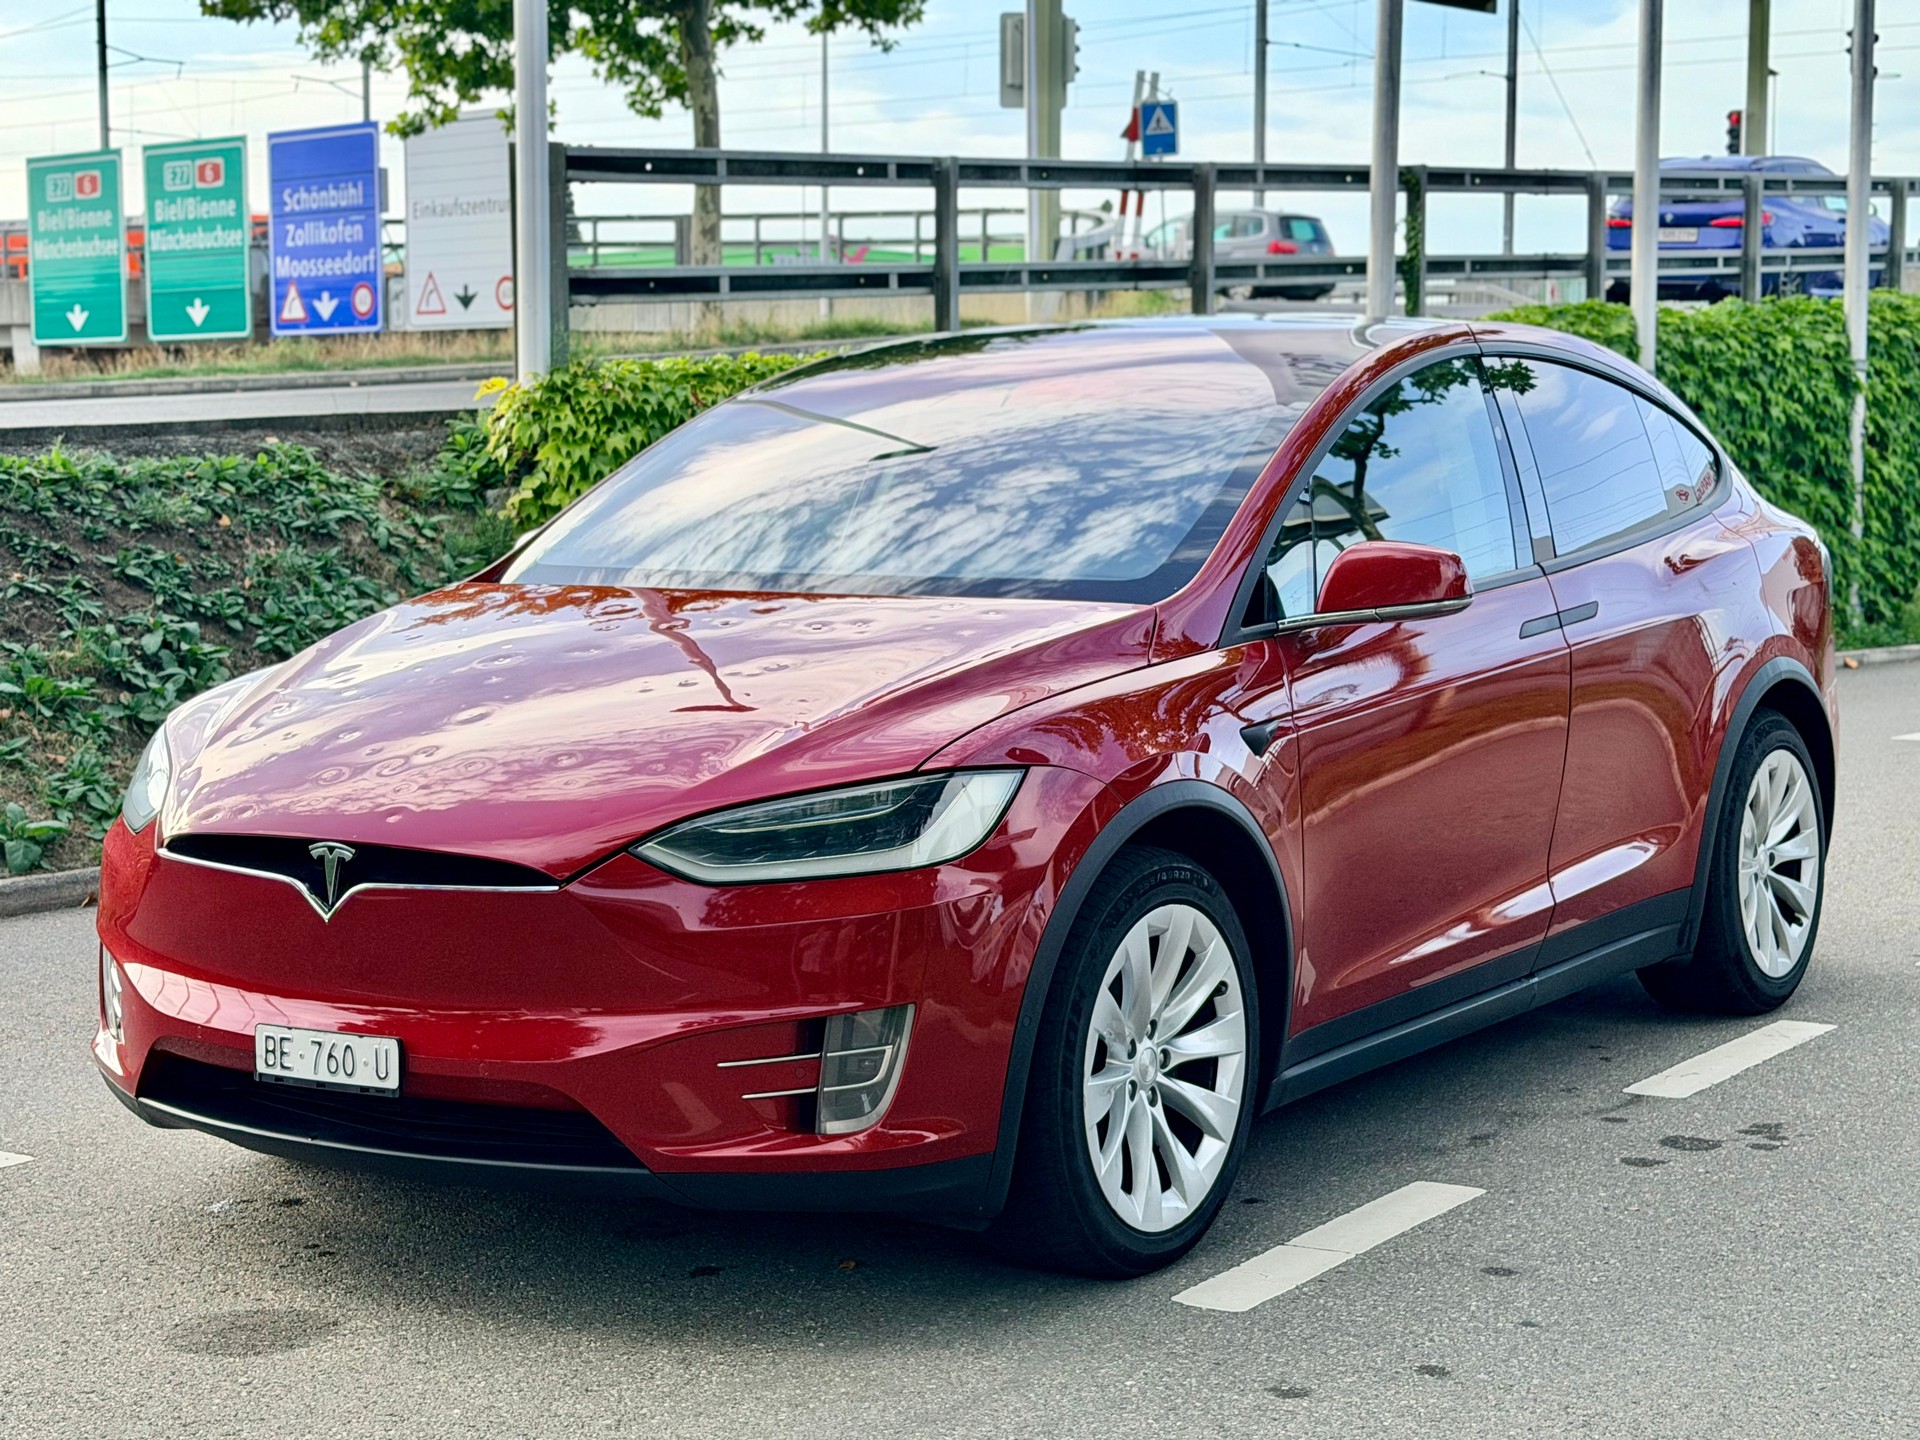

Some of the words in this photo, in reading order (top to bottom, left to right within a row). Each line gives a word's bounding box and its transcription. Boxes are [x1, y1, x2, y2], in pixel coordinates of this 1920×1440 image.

[154, 195, 236, 223] Biel/Bienne
[283, 181, 363, 212] Schönbühl
[412, 197, 510, 220] Einkaufszentru
[38, 207, 113, 232] Biel/Bienne
[285, 217, 363, 247] Zollikofen
[276, 248, 375, 278] Moosseedorf
